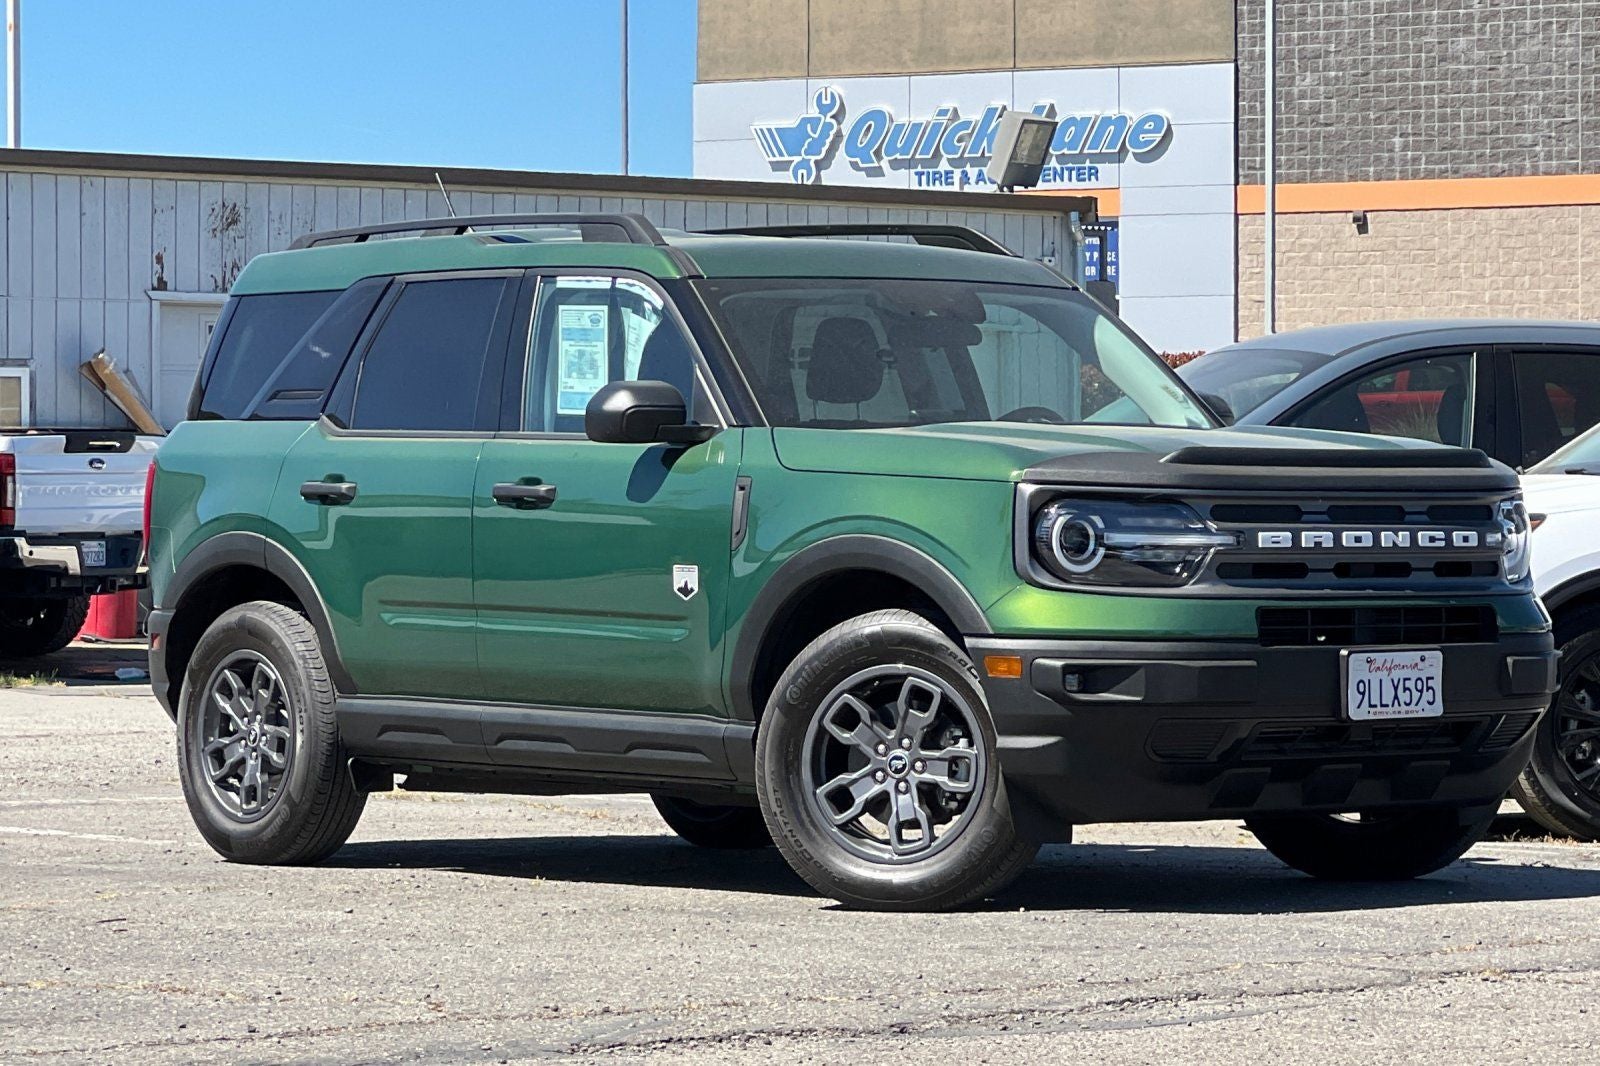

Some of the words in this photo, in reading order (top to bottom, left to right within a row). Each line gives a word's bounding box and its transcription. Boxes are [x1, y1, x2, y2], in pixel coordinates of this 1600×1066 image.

[844, 105, 1005, 168] Quick
[1031, 103, 1168, 154] ane
[914, 169, 955, 187] TIRE
[960, 169, 971, 186] &
[1041, 165, 1099, 183] ENTER
[1257, 530, 1479, 549] BRONCO
[1368, 657, 1424, 677] California
[1356, 676, 1436, 709] 9LLX595
